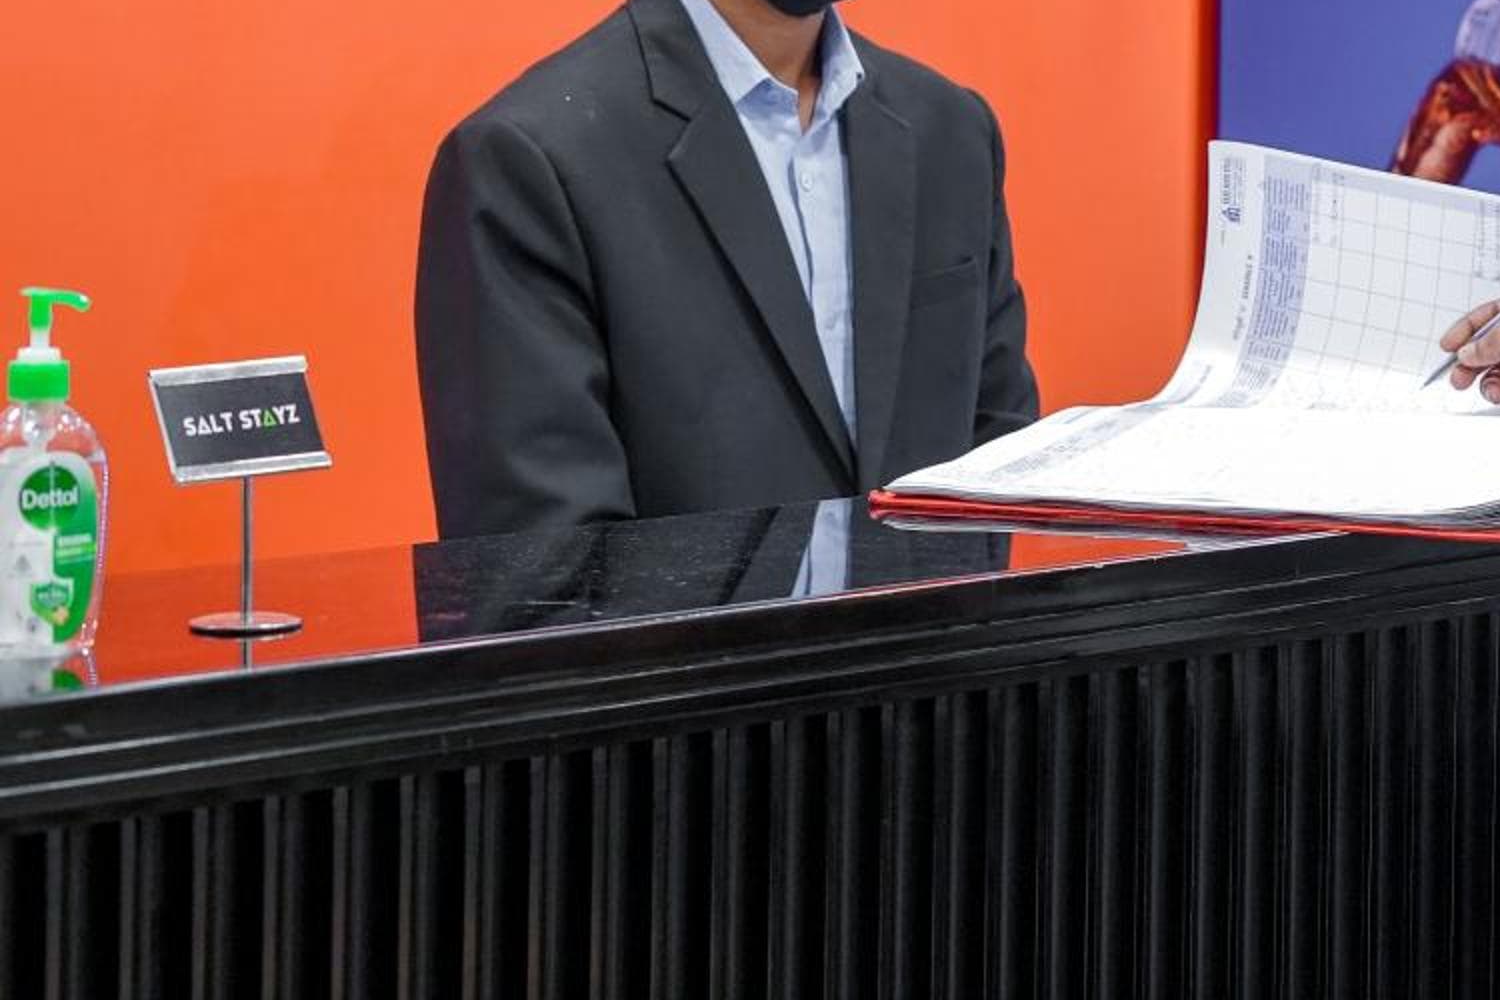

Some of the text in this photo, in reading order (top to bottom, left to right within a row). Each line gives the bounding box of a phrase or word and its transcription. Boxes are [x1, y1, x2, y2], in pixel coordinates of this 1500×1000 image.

[183, 404, 301, 436] SALT STAYZ
[21, 488, 78, 510] Dettol
